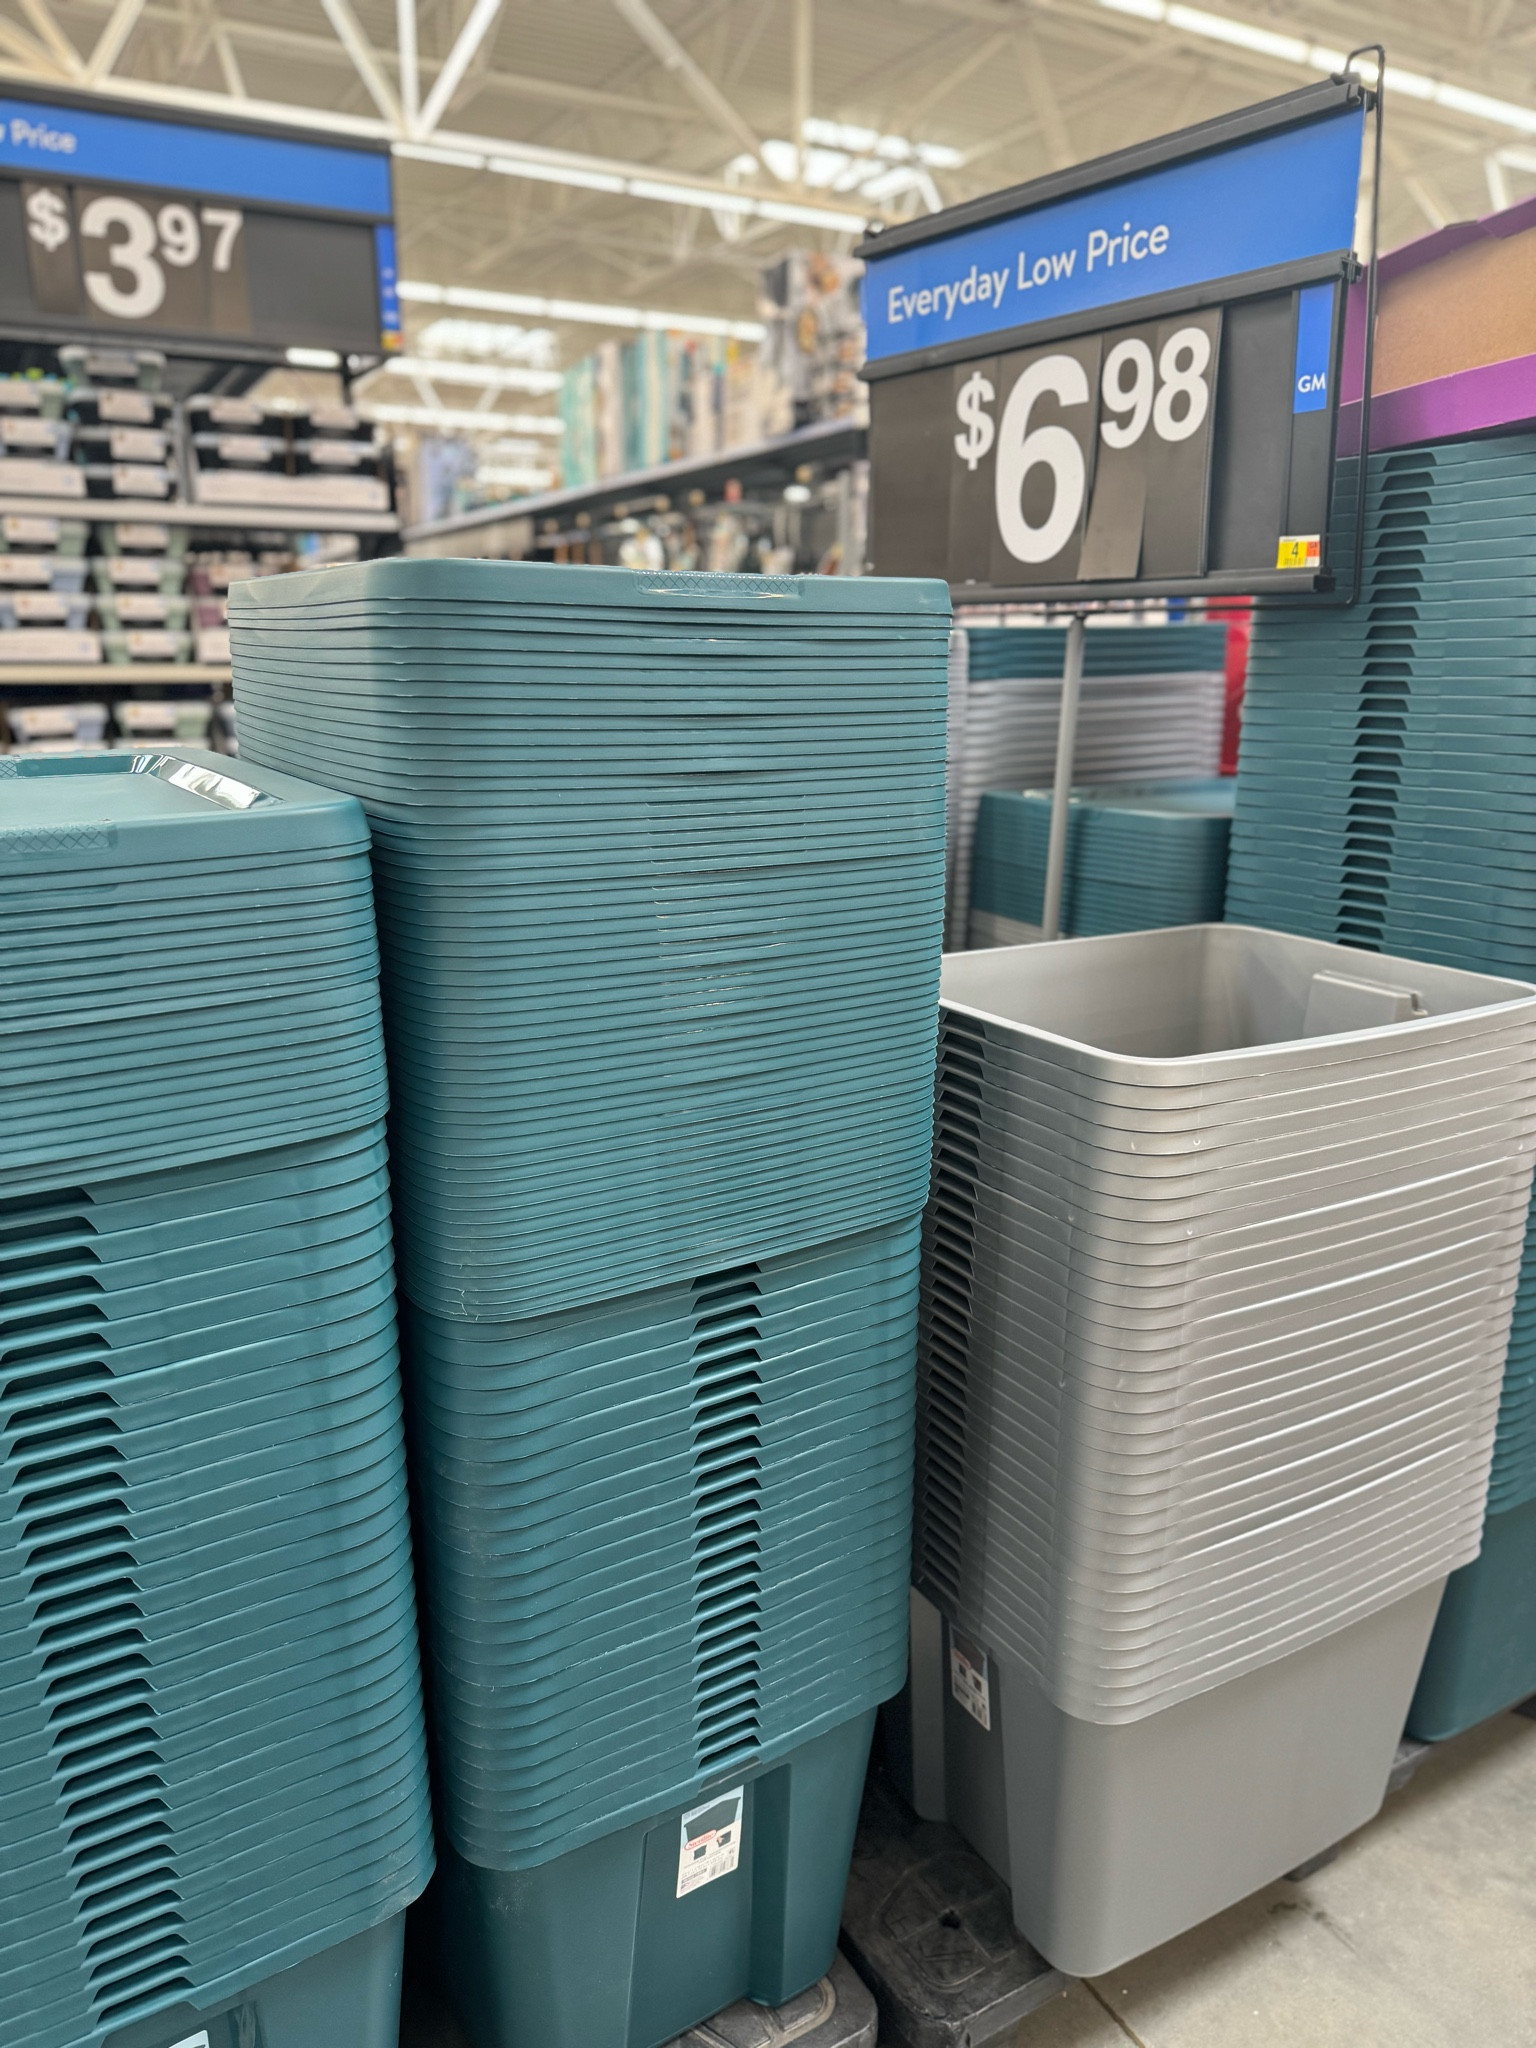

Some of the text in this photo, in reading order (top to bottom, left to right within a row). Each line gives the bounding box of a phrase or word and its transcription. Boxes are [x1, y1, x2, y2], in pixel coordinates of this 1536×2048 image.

[9, 118, 78, 154] Price
[888, 222, 1170, 324] Everyday Low Price
[1297, 372, 1326, 393] GM
